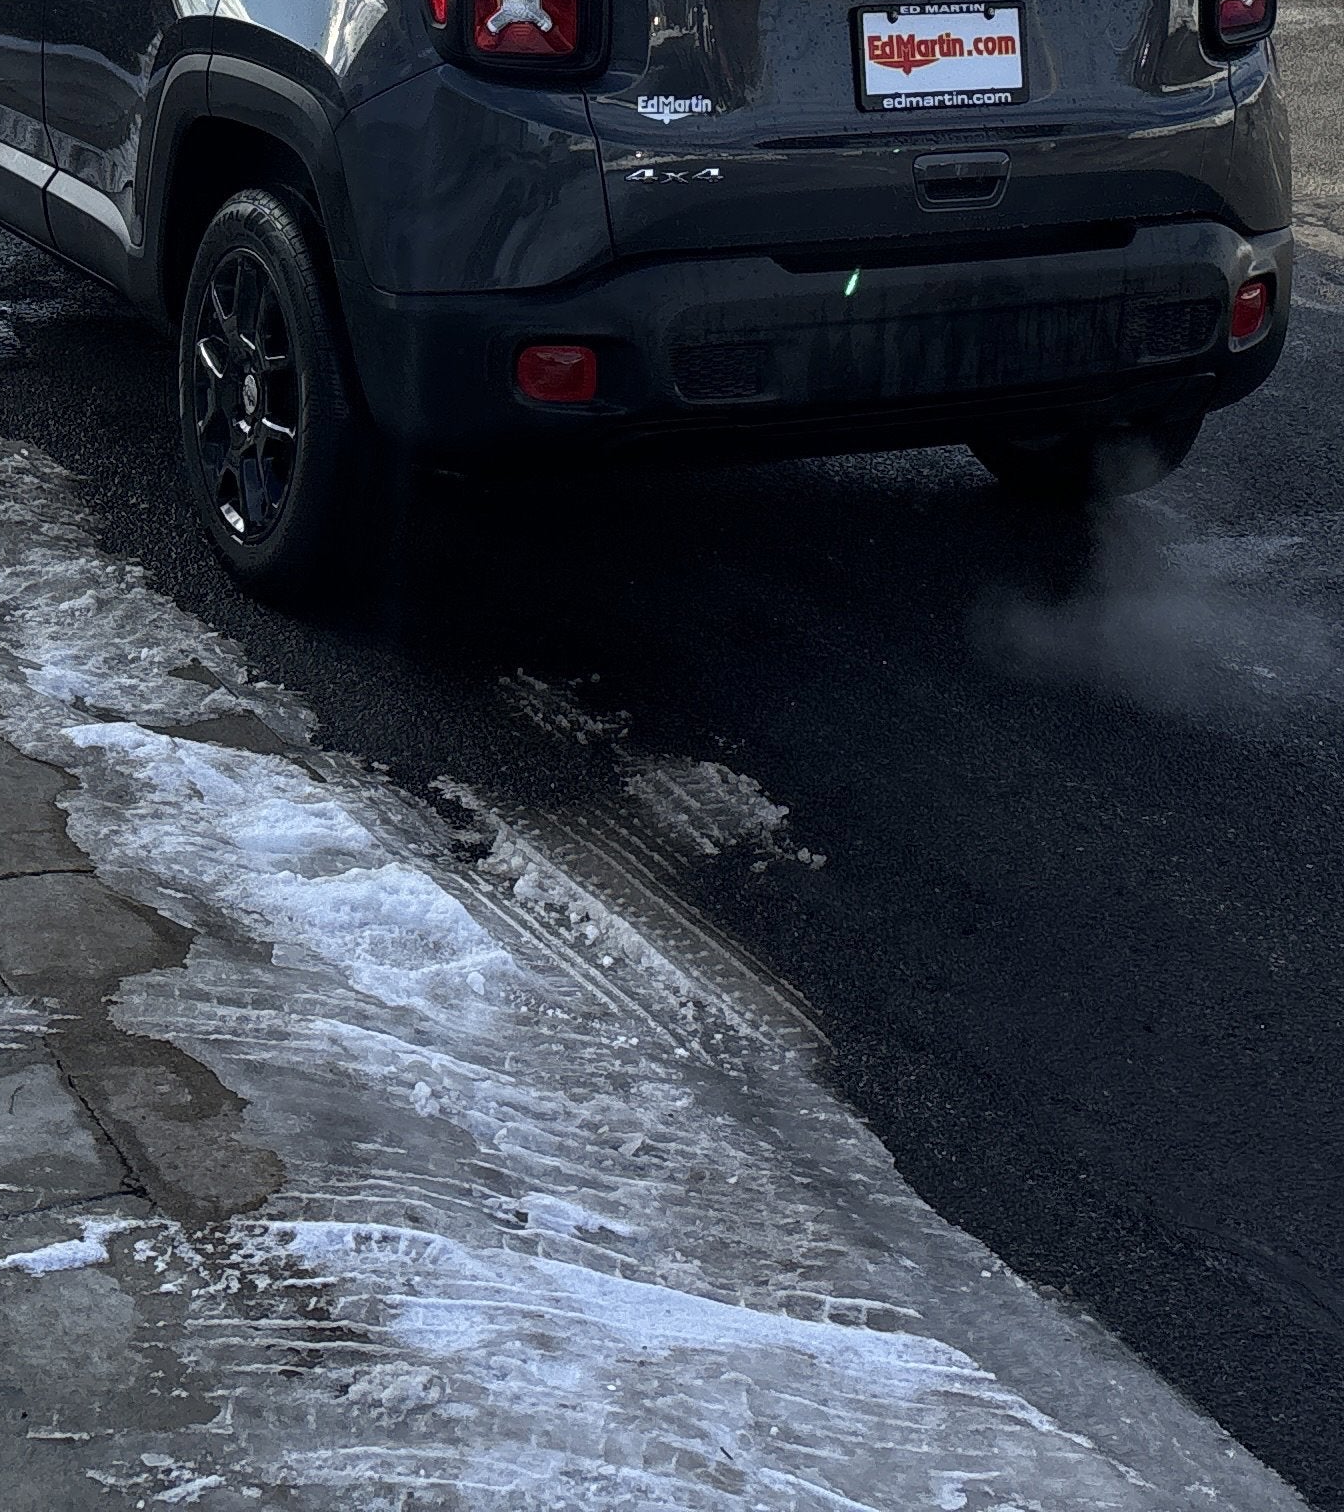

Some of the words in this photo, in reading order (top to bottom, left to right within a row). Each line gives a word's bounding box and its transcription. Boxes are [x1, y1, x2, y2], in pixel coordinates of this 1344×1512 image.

[899, 5, 921, 15] ED
[925, 3, 986, 14] MARTIN
[882, 91, 1012, 110] edmartin.com
